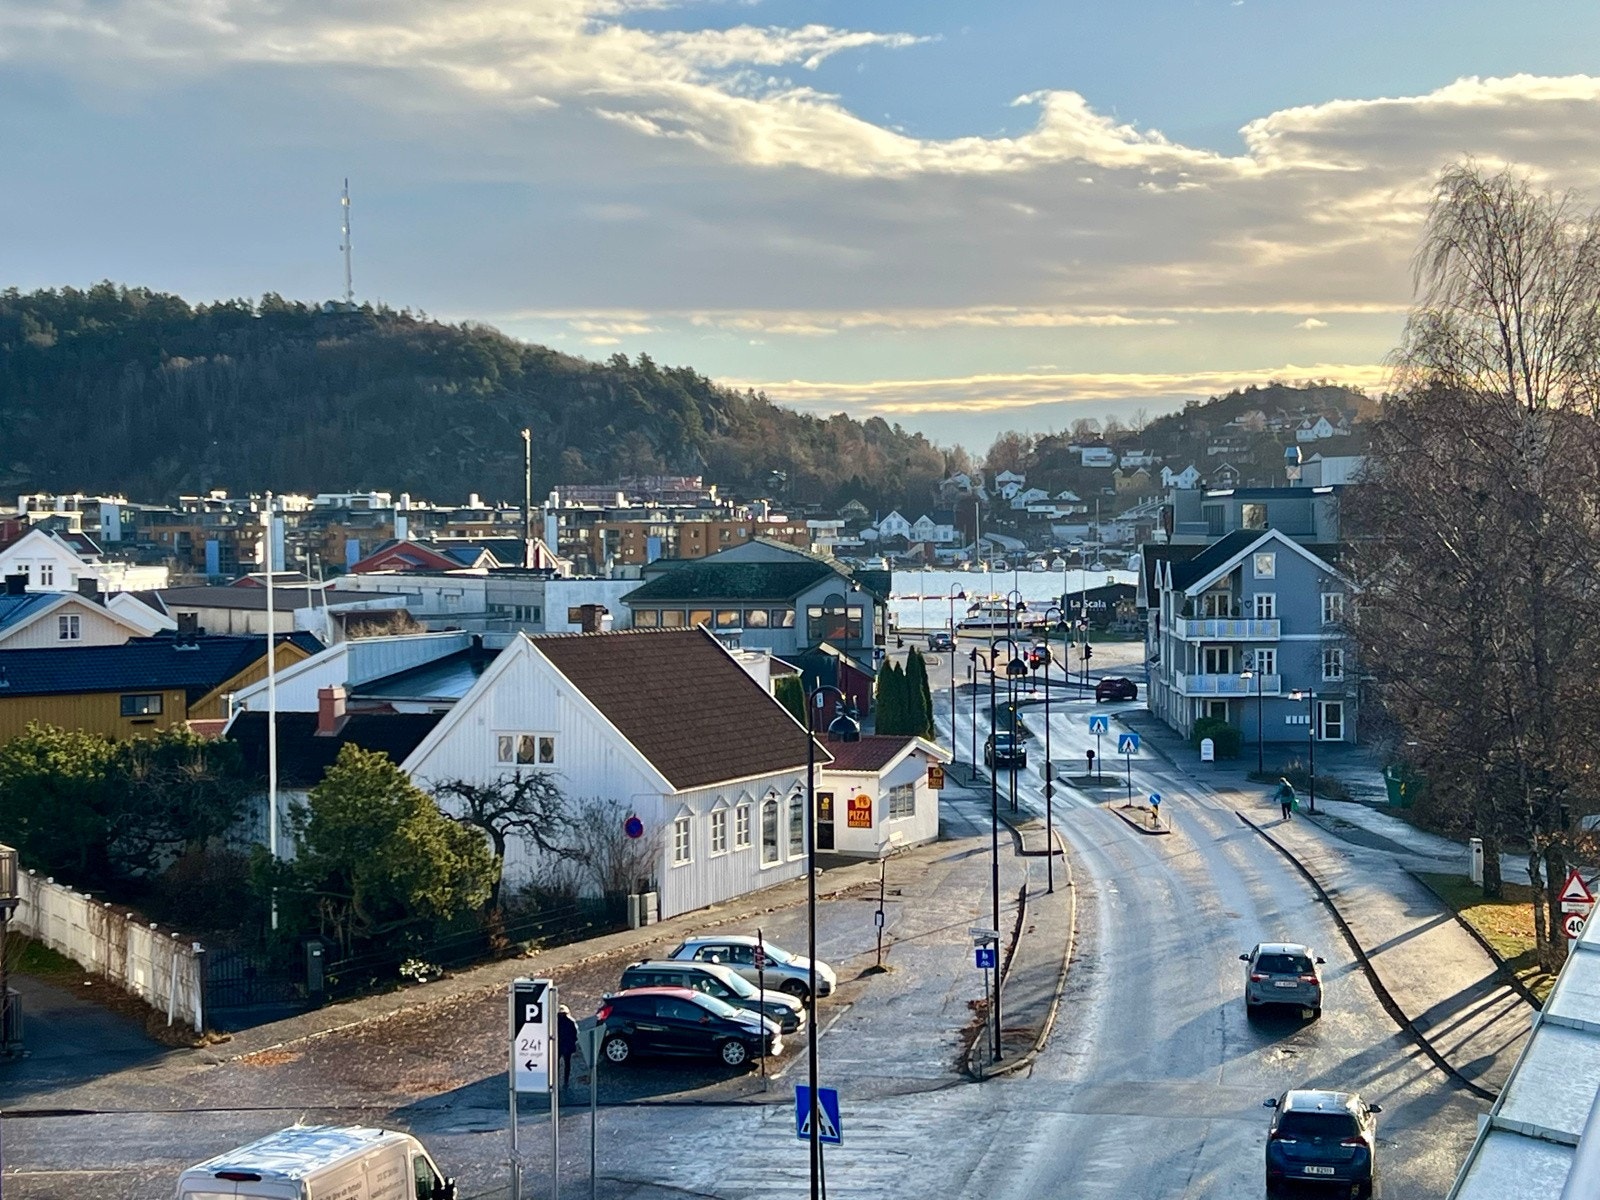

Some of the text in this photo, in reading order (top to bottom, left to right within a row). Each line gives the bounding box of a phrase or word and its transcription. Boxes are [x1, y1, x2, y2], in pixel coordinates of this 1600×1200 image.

[1070, 600, 1107, 608] La Scala
[848, 810, 870, 820] PIZZA
[1568, 920, 1584, 933] 40
[525, 1003, 539, 1021] P
